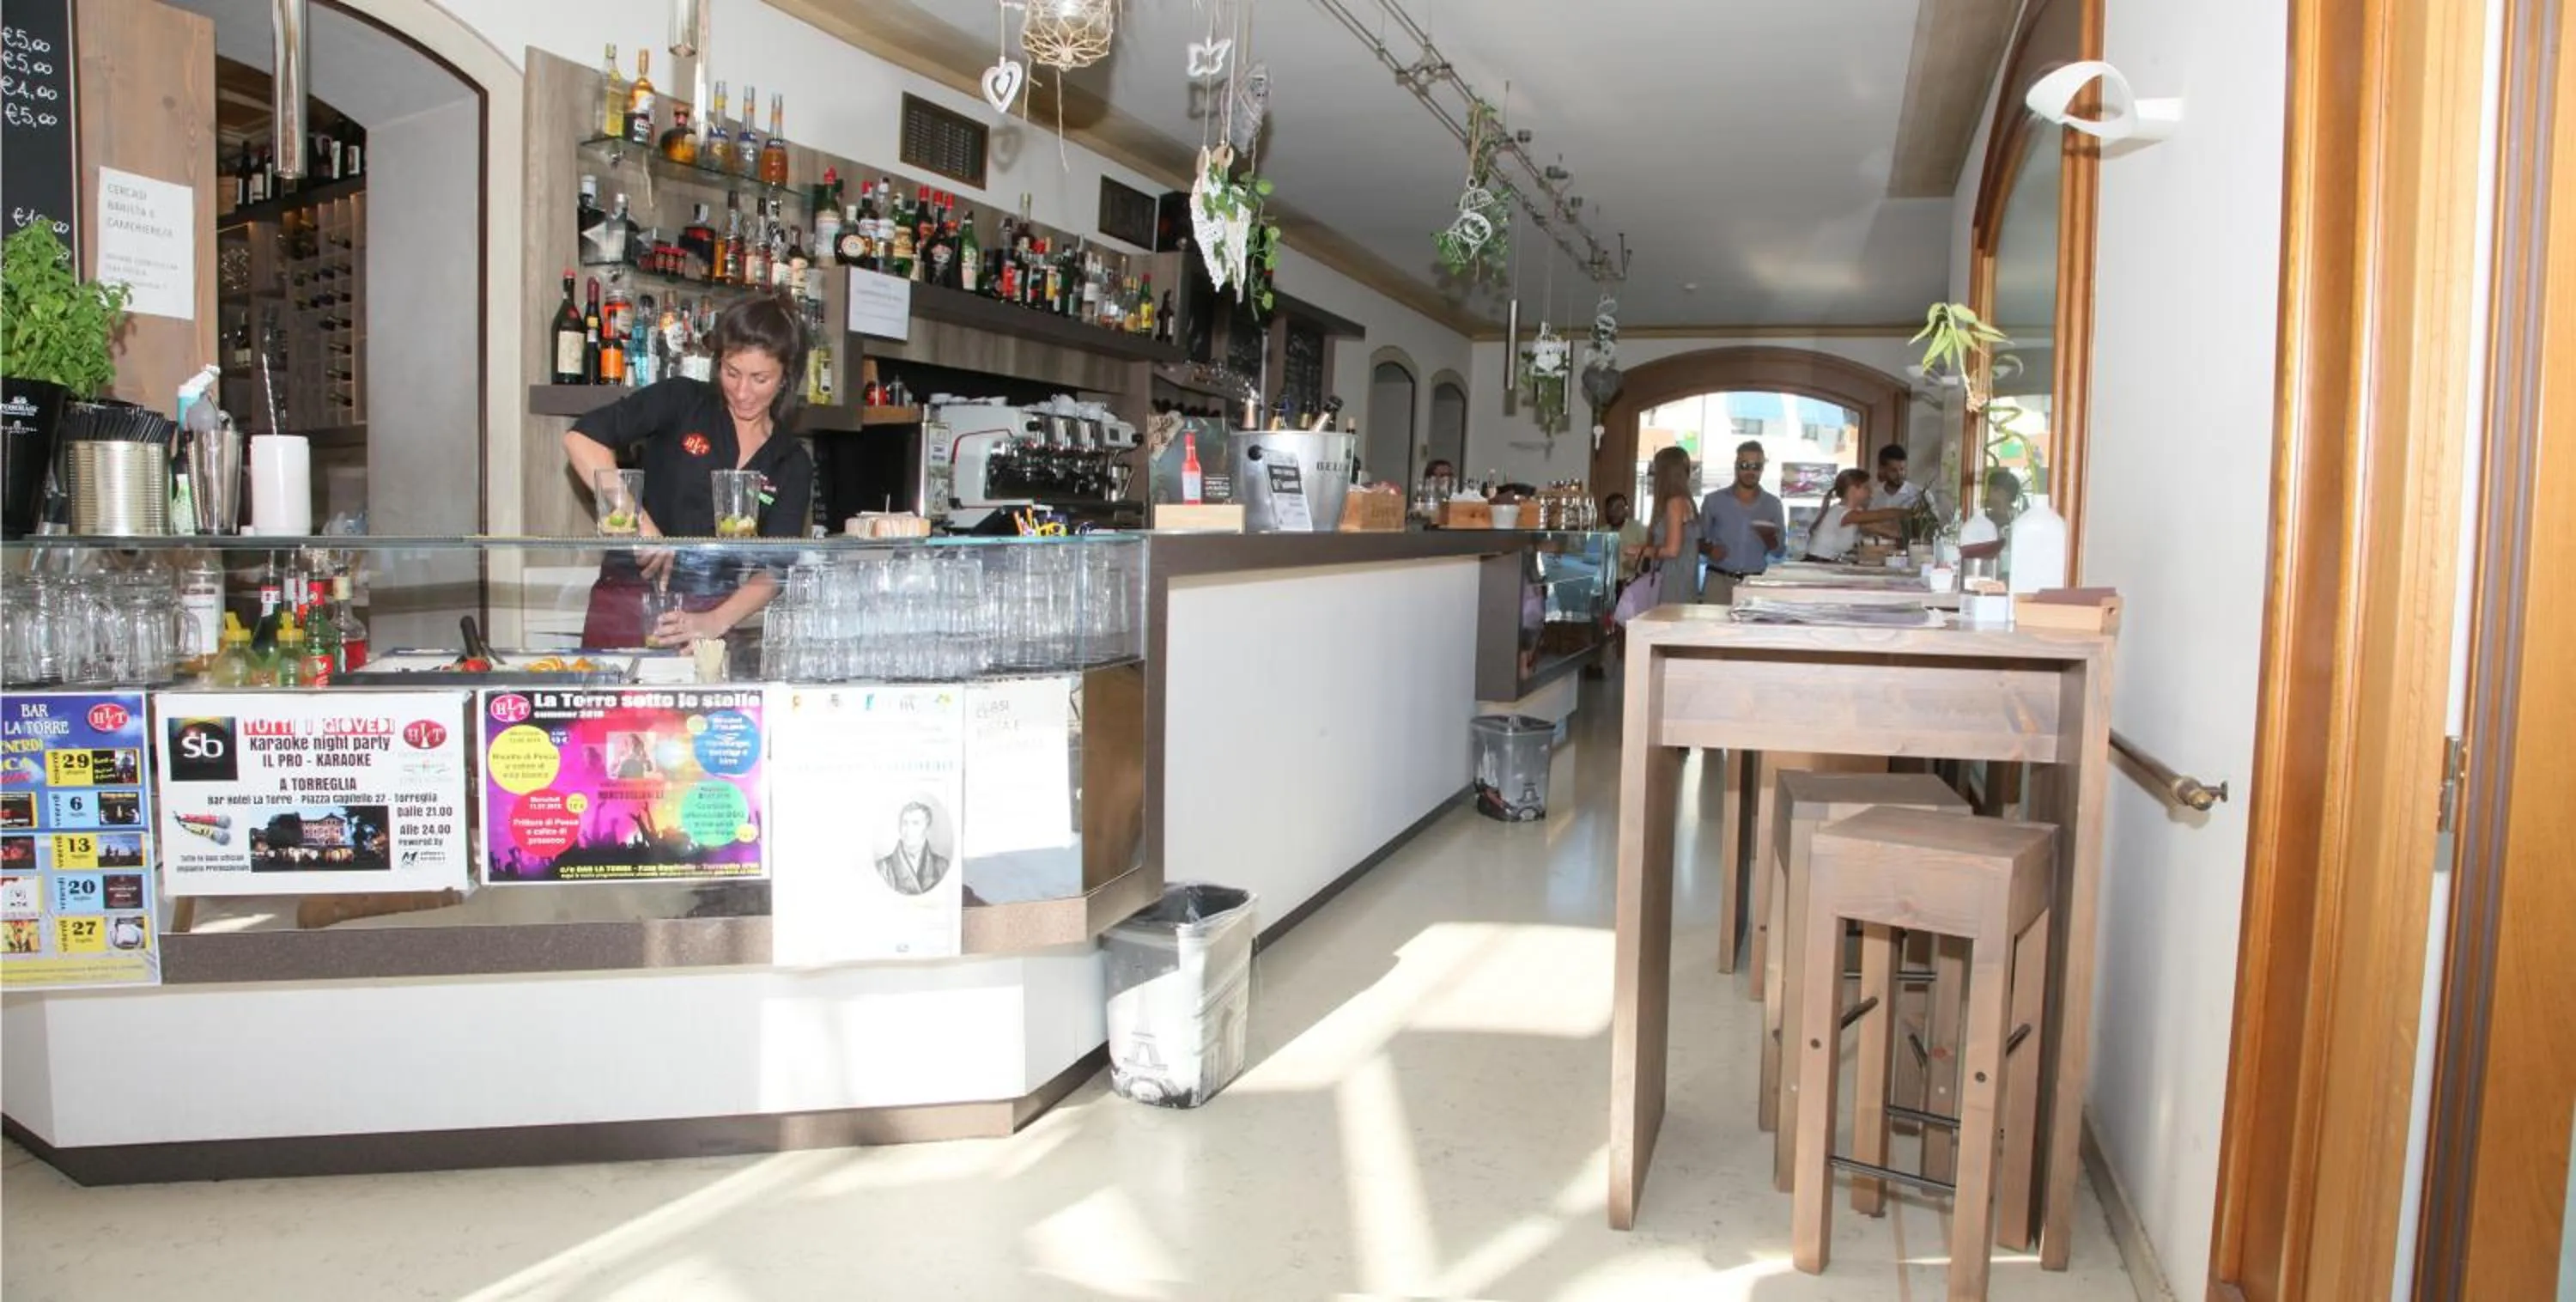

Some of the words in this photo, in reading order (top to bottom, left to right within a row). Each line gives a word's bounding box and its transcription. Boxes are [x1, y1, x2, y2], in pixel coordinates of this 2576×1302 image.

[533, 693, 557, 708] La
[561, 693, 617, 708] Torre
[621, 693, 672, 708] sotto
[677, 693, 697, 709] le
[702, 693, 760, 708] stelle
[21, 703, 49, 718] BAR
[533, 710, 578, 719] summer
[5, 721, 21, 734] LA
[23, 721, 70, 734] TORRE
[243, 718, 295, 735] TUTTI
[250, 736, 308, 751] Karaoke
[313, 736, 348, 752] night
[353, 736, 390, 751] party
[63, 754, 89, 768] 29
[263, 754, 275, 768] IL
[278, 754, 302, 767] PRO
[316, 753, 371, 767] KARAOKE
[280, 777, 287, 791] A
[291, 777, 356, 791] TORREGLIA
[70, 796, 83, 811] 6
[397, 806, 423, 817] Dalle
[426, 806, 453, 817] 21.00
[400, 824, 419, 835] Alle
[68, 838, 91, 853] 13
[68, 879, 96, 894] 20
[71, 922, 97, 935] 27
